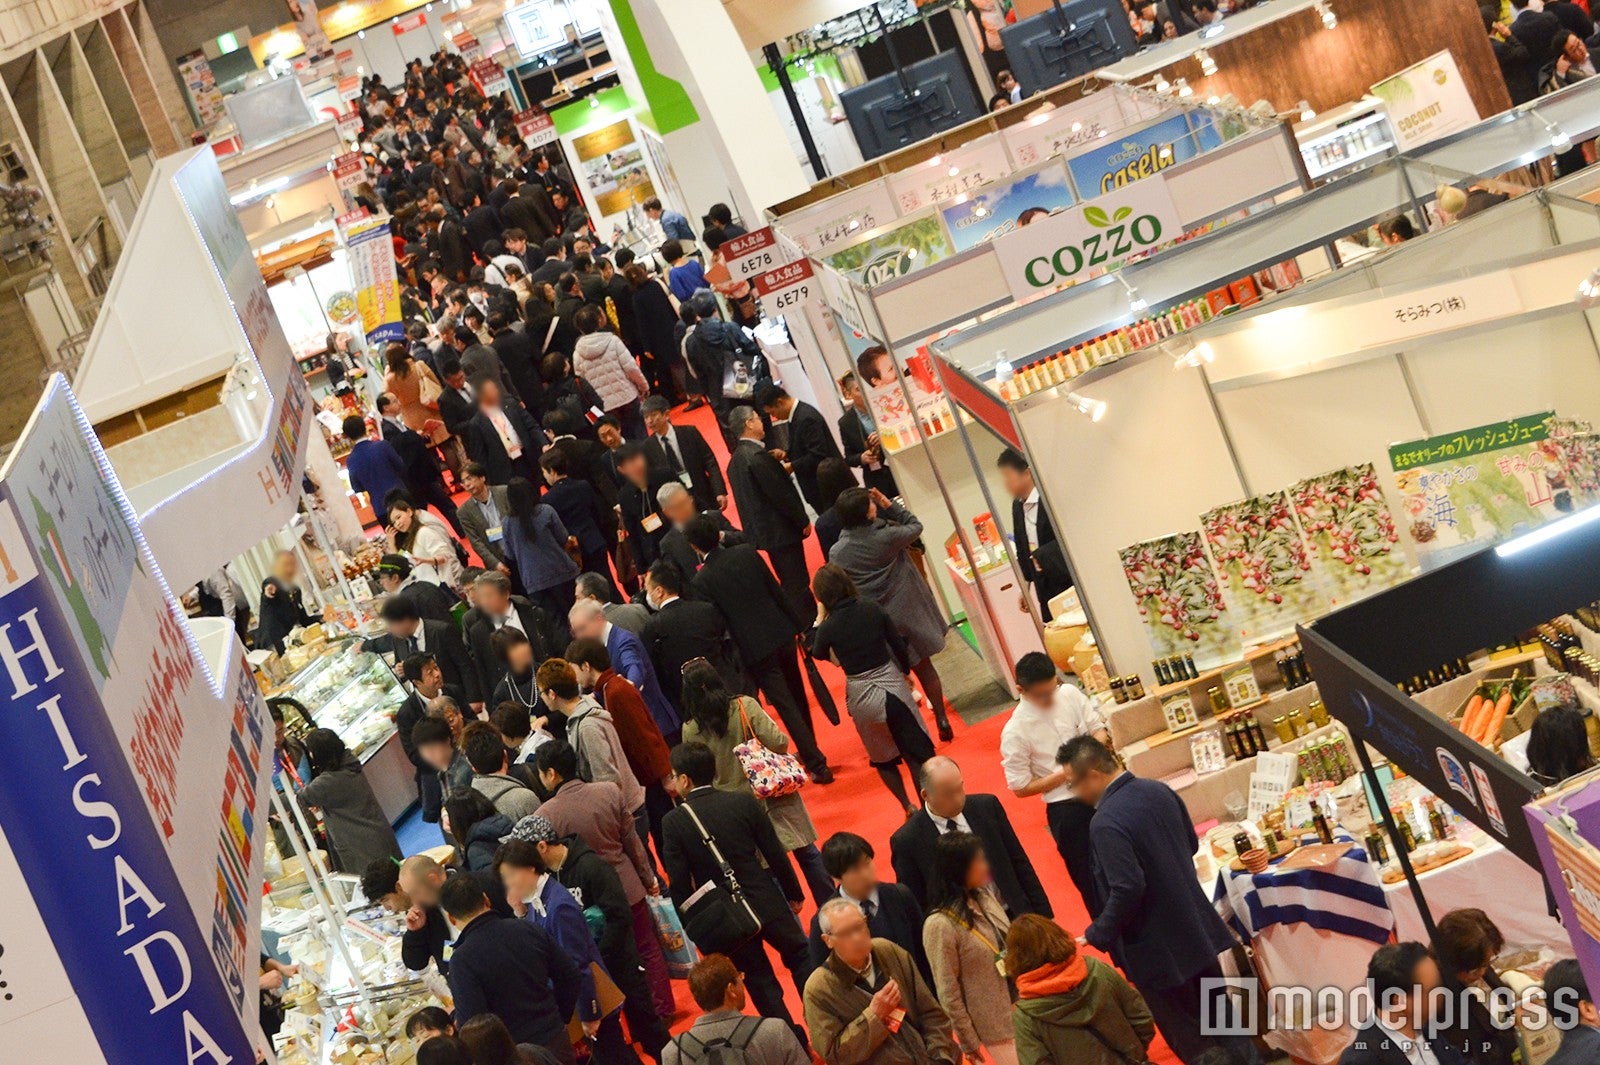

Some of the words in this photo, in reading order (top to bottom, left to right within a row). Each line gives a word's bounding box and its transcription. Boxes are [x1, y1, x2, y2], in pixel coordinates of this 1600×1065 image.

[1398, 102, 1442, 132] COCONUT
[730, 232, 766, 254] 輸入食品
[1024, 214, 1161, 288] COZZO
[741, 253, 772, 273] 6E78
[764, 263, 804, 286] 輸入食品
[776, 286, 808, 308] 6E79
[1395, 295, 1467, 323] そらみつ(株)
[1496, 451, 1544, 477] 甘みの
[1419, 466, 1478, 492] 爽やかさの
[1526, 472, 1552, 507] 山
[1426, 494, 1458, 529] 海
[0, 607, 233, 1065] HISADA
